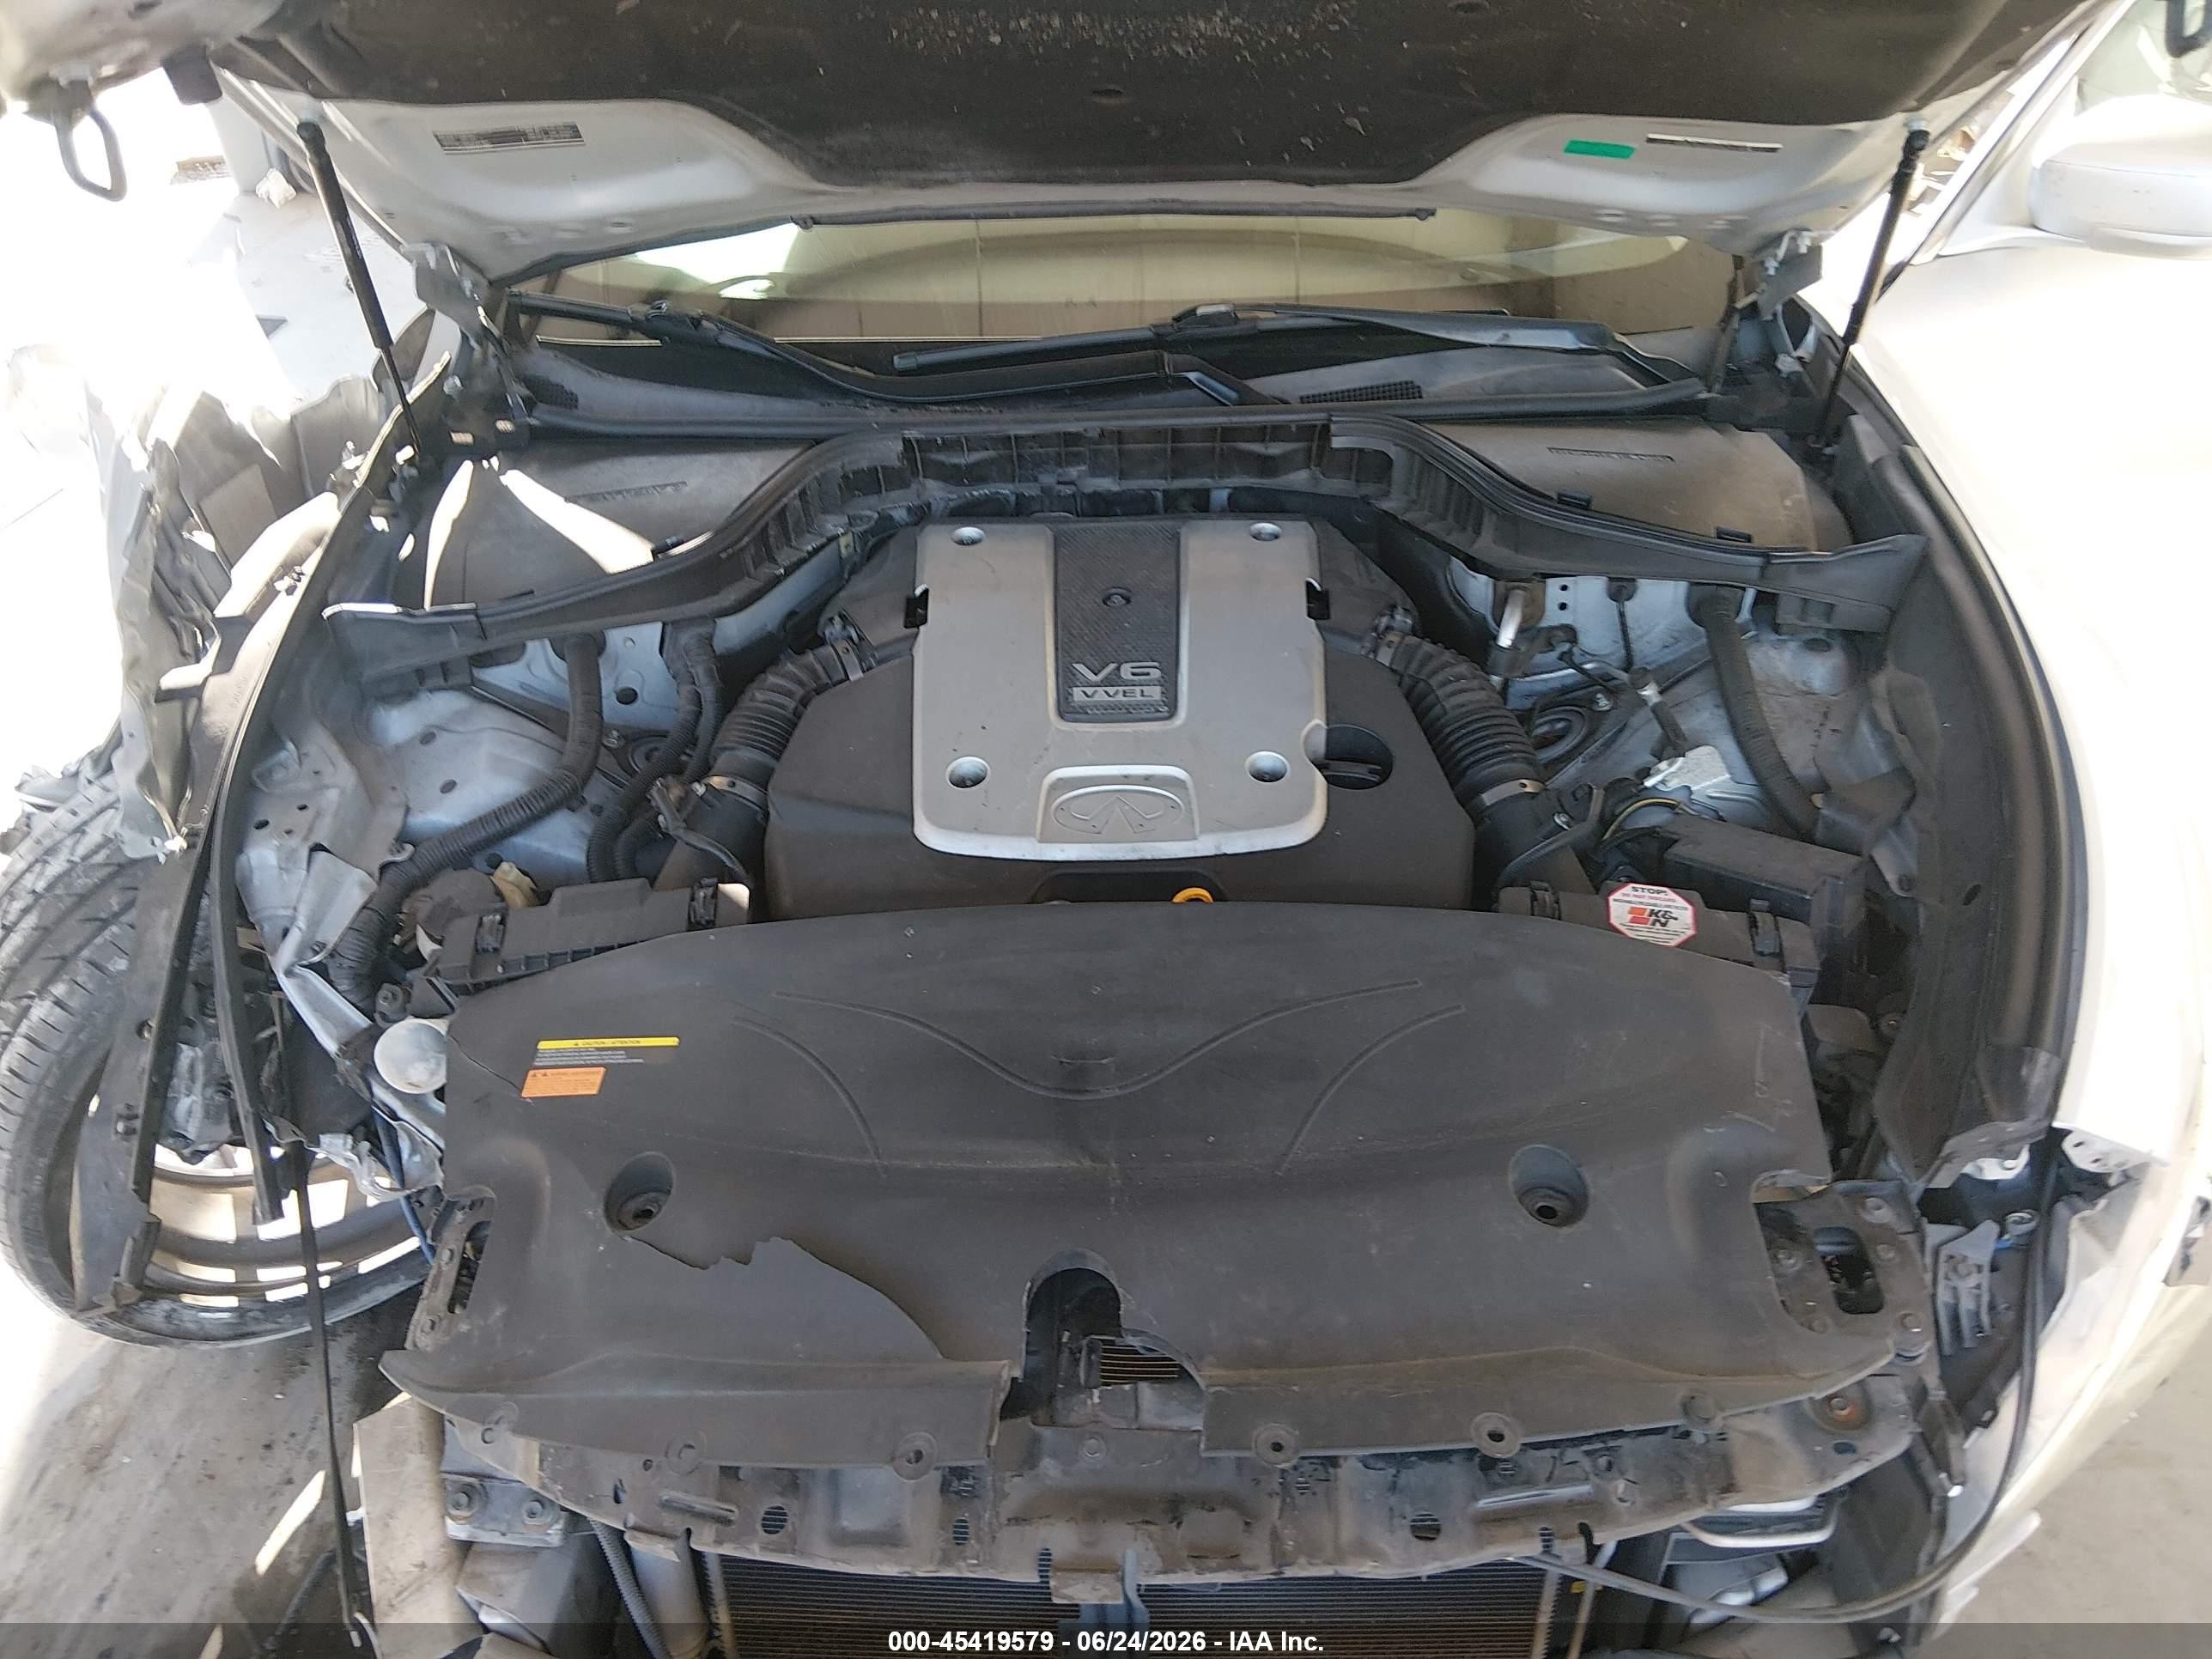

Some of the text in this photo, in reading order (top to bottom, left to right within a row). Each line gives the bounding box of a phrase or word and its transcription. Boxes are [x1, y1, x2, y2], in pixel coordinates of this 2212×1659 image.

[1072, 661, 1162, 682] V6
[1080, 689, 1154, 699] VVEL
[1631, 886, 1669, 896] STOP!
